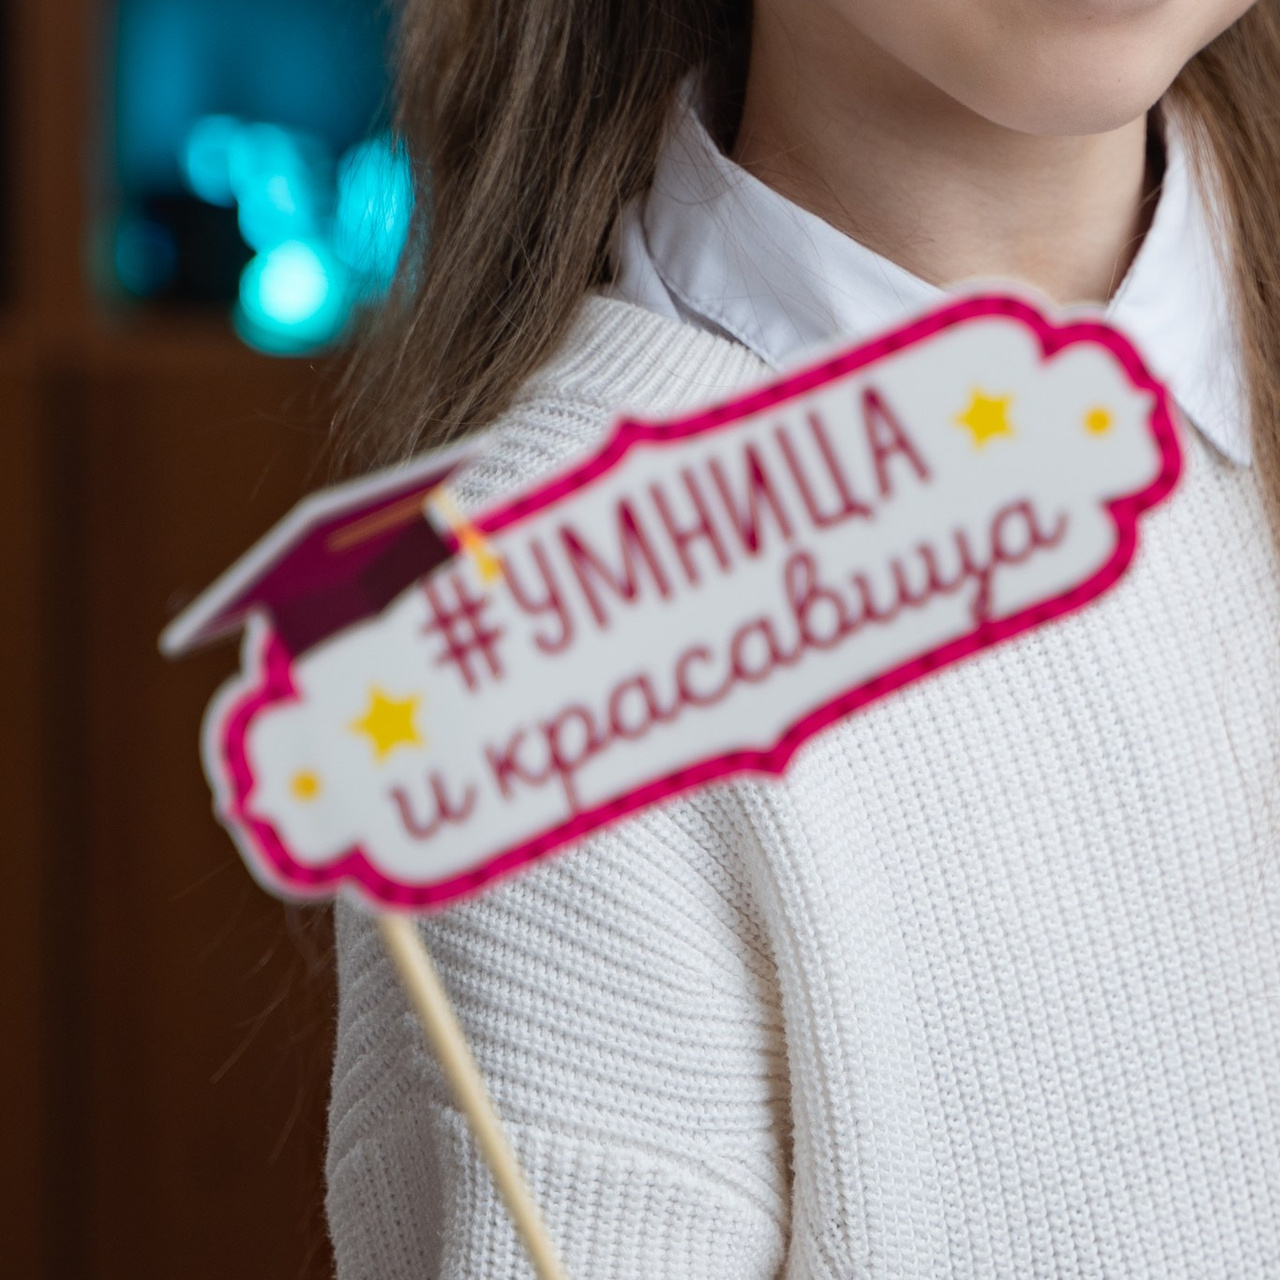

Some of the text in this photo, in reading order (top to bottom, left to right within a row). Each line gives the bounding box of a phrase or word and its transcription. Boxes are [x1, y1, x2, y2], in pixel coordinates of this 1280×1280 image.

[391, 495, 1070, 842] и красавица
[421, 384, 931, 692] #УМНИЦА
